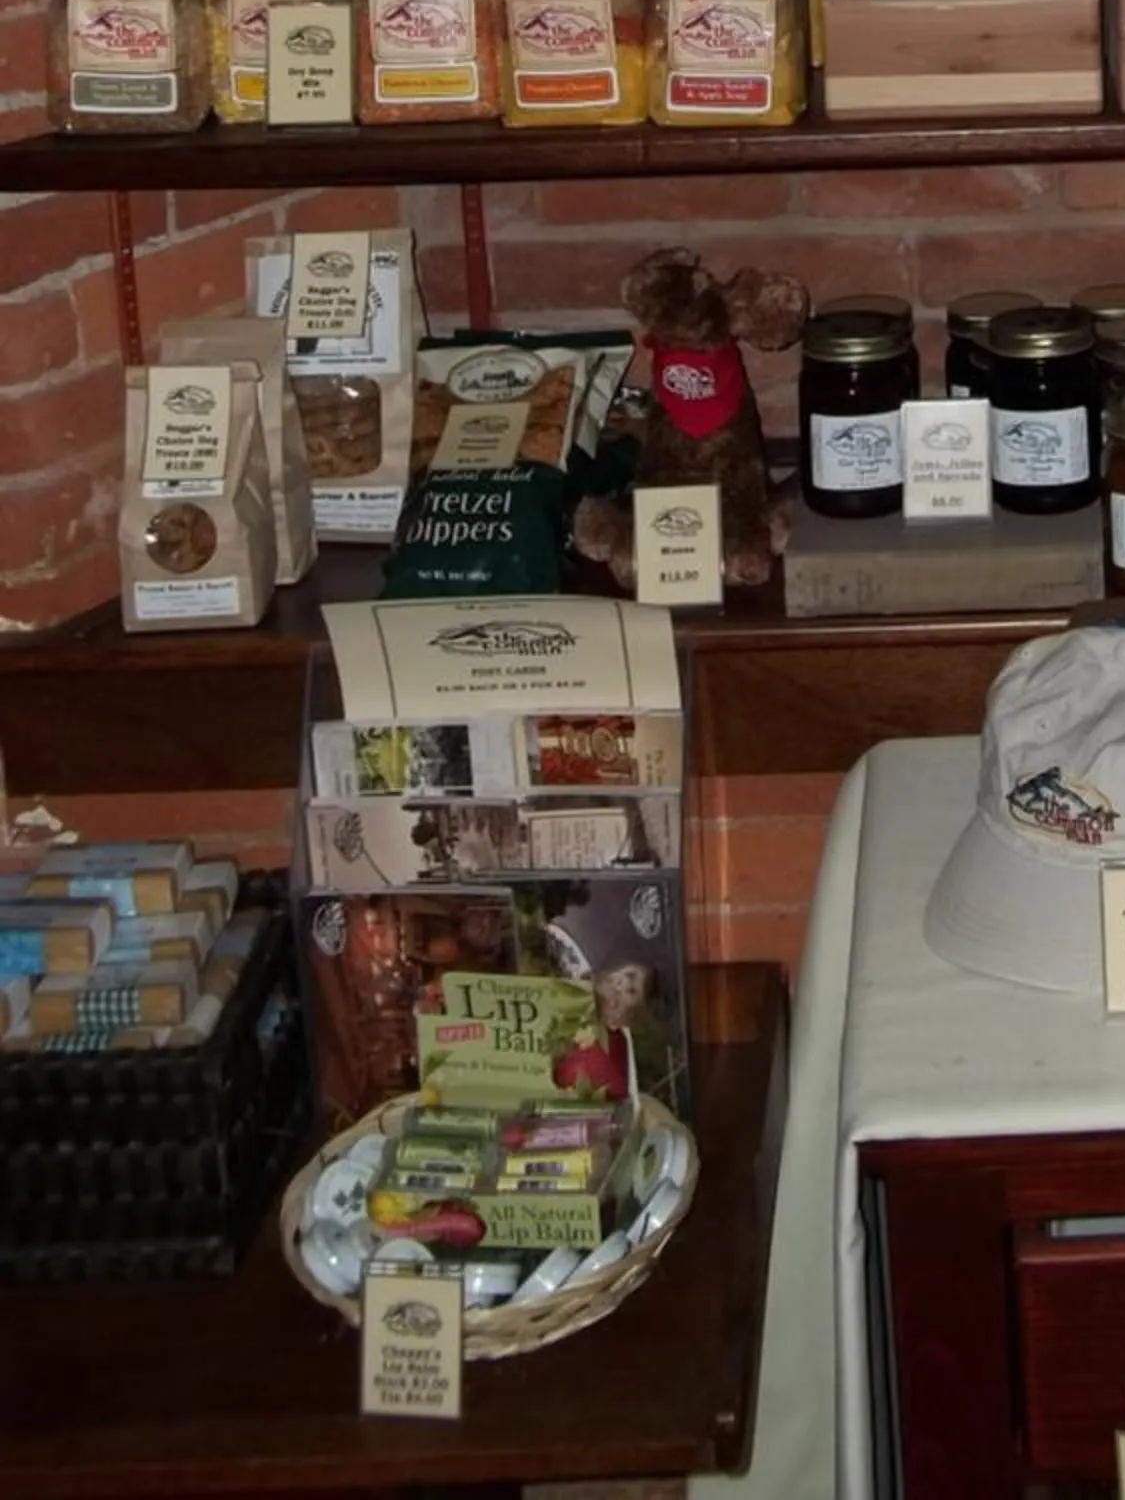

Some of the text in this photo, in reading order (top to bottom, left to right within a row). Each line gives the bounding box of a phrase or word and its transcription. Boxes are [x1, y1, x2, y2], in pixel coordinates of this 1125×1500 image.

[455, 983, 540, 1034] Lip
[520, 1203, 594, 1221] Natural
[490, 1221, 596, 1245] Lip Balm
